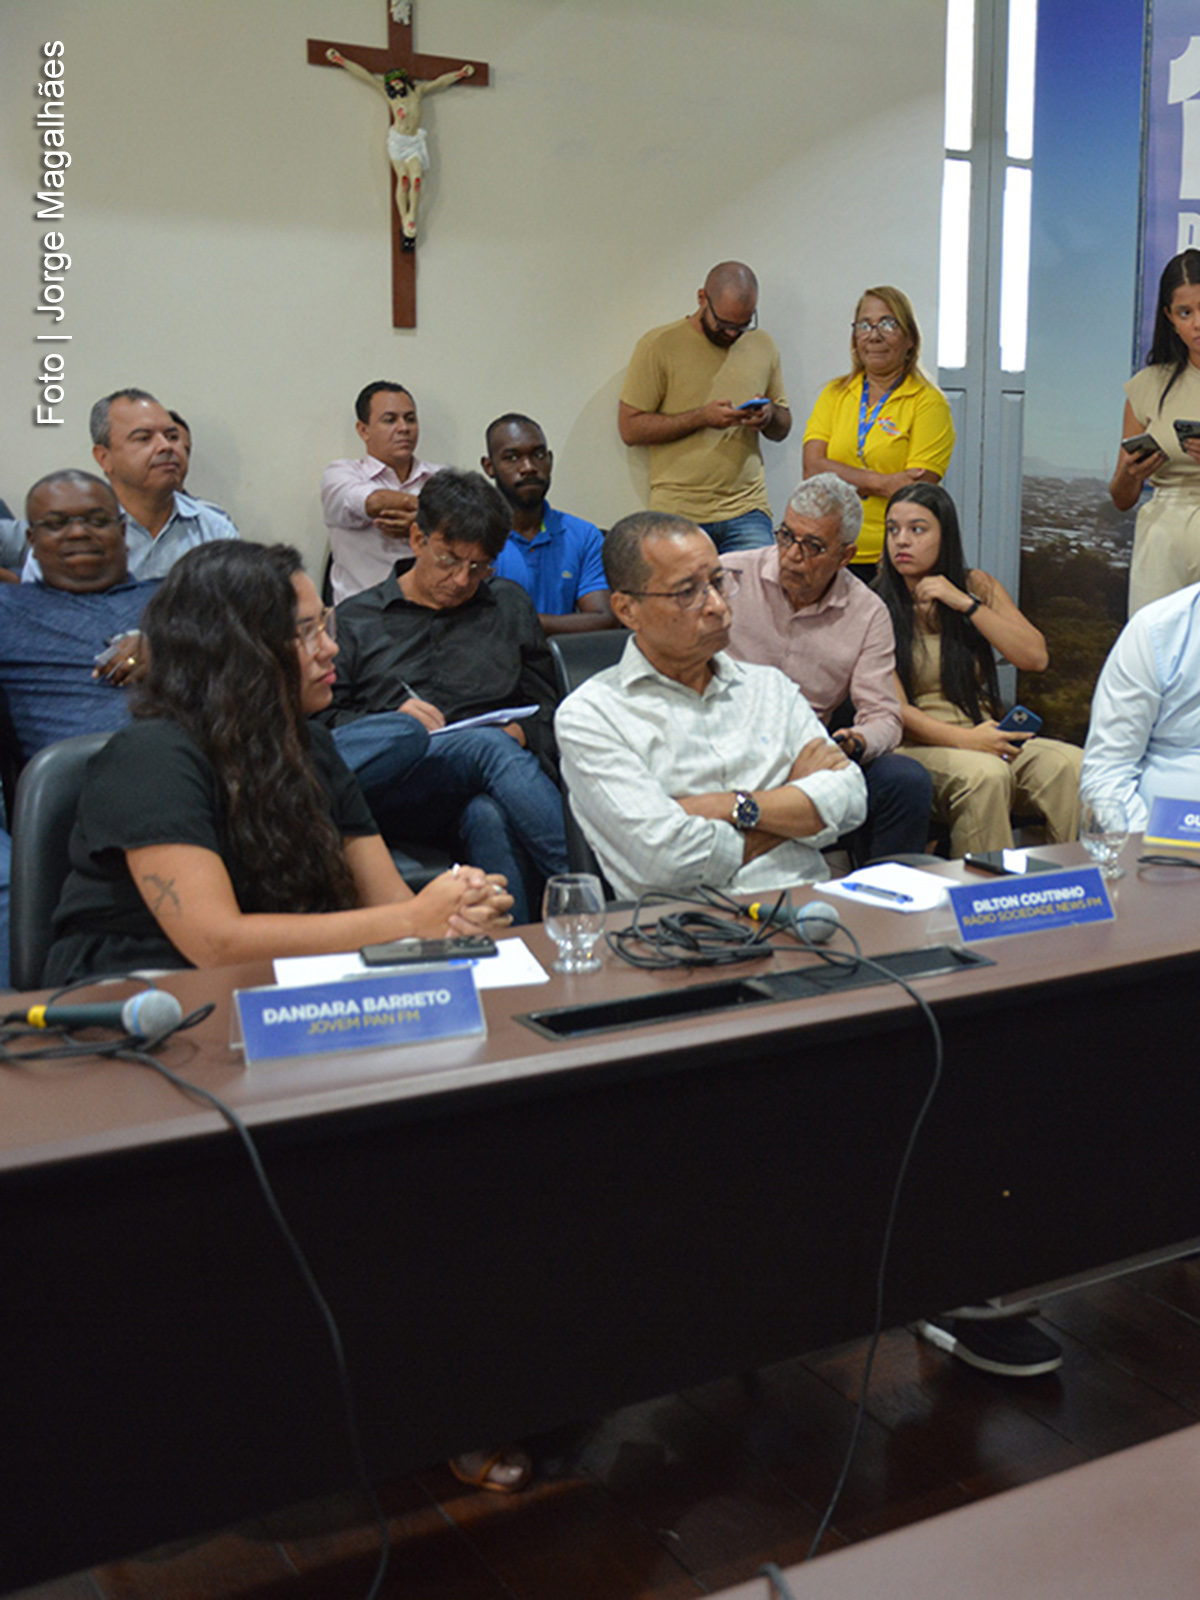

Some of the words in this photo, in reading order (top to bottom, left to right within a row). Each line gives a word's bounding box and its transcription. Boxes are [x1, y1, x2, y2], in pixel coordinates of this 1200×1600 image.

[973, 894, 1020, 914] DILTON
[1020, 886, 1085, 905] COUTINHO
[262, 999, 360, 1026] DANDARA
[362, 989, 451, 1014] BARRETO
[307, 1016, 360, 1035] JOVEM
[362, 1012, 396, 1029] PAN
[397, 1008, 421, 1024] FM
